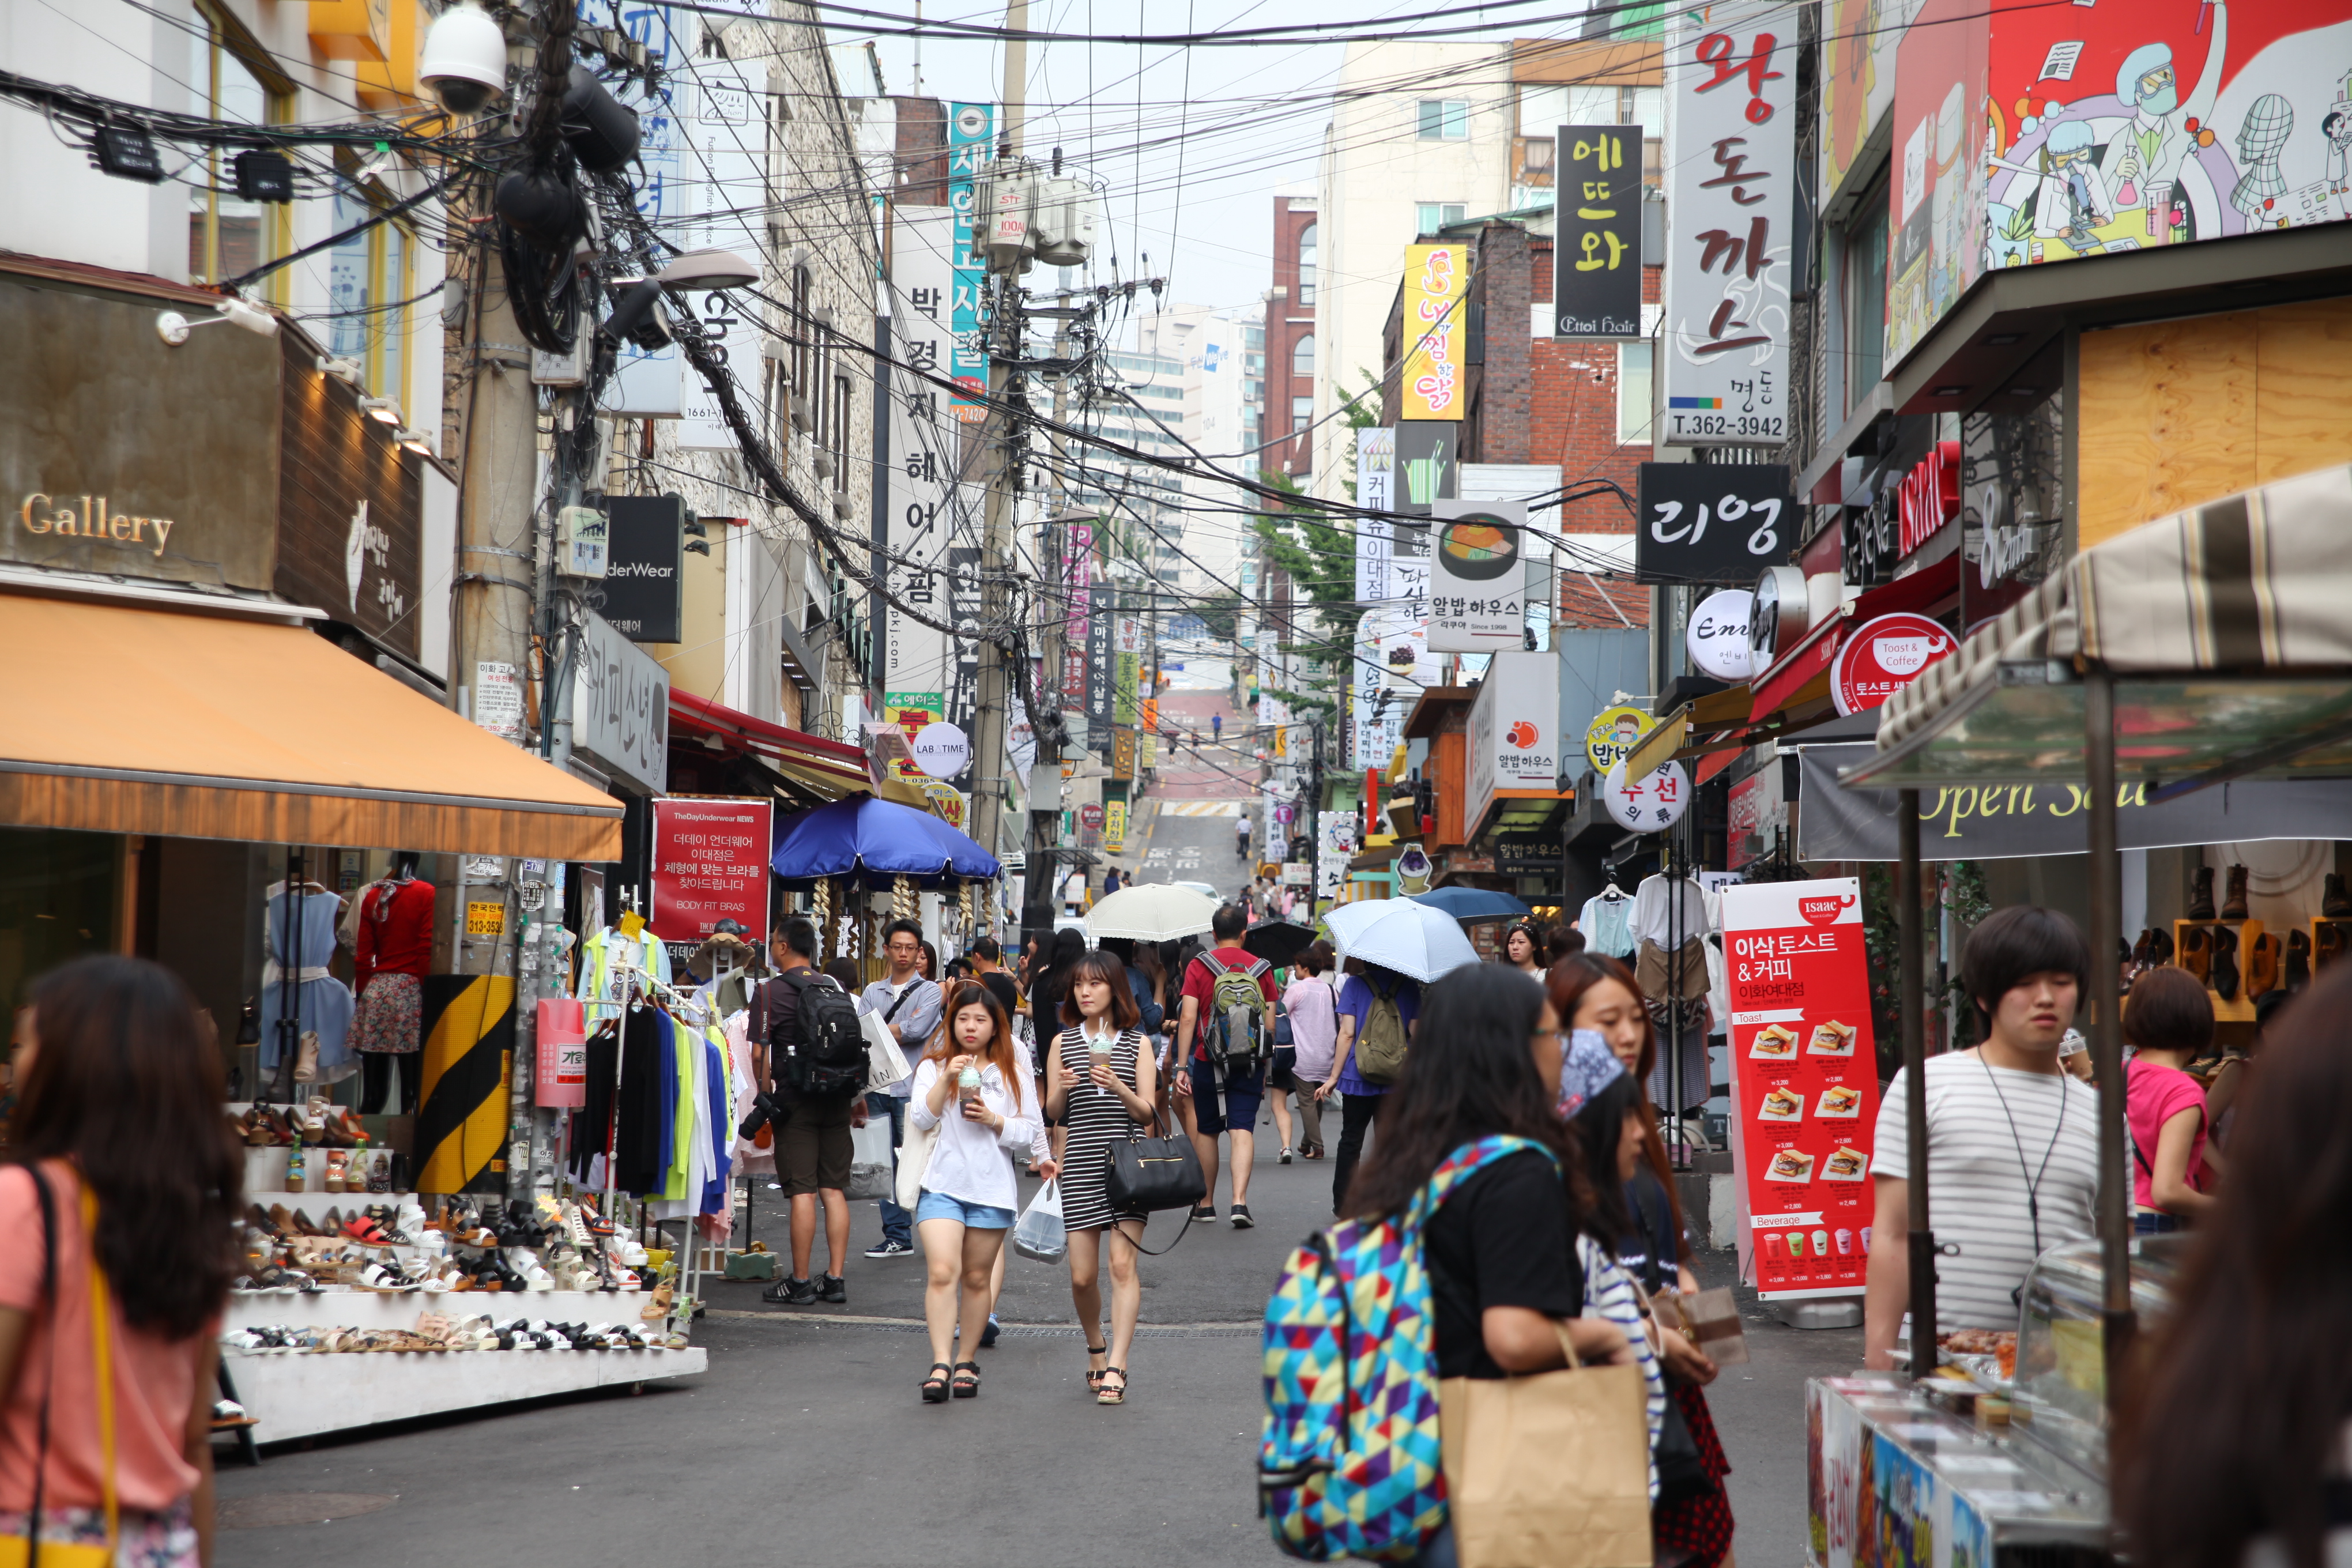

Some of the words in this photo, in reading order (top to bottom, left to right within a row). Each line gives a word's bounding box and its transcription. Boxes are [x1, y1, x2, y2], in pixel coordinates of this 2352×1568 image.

[708, 137, 716, 164] Fusion
[1694, 33, 1785, 355] 왕돈까스
[1573, 133, 1628, 272] 에뜨와
[706, 224, 714, 244] Rice
[1600, 315, 1635, 333] Hair
[1731, 371, 1773, 414] 명동
[1673, 416, 1782, 437] T.362-3942
[23, 494, 172, 557] Gallery
[1651, 494, 1782, 556] 리영
[1441, 621, 1467, 630] 라쿠야
[1883, 643, 1909, 653] Toast
[1911, 643, 1918, 652] &
[1719, 650, 1747, 665] 엔비
[1886, 656, 1918, 666] Coffee
[480, 664, 496, 673] 이화
[488, 675, 514, 684] 여성전용
[904, 694, 938, 706] 에이스
[1842, 681, 1853, 704] Toast
[591, 638, 650, 770] 커피소년
[1590, 723, 1614, 740] 봉구스
[943, 745, 964, 753] TIME
[674, 812, 736, 822] TheDayUnderwear
[1110, 809, 1121, 840] 주차장
[674, 834, 706, 846] 더데이
[710, 835, 753, 848] 언더웨어
[691, 849, 735, 862] 이대점은
[664, 862, 698, 875] 체형에
[701, 864, 723, 876] 맞는
[726, 865, 760, 877] 브라를
[679, 877, 744, 891] 찾아드립니다
[676, 900, 702, 910] BODY
[704, 902, 718, 910] FIT
[720, 902, 745, 912] BRAS
[1735, 936, 1775, 959] 이삭
[1778, 933, 1838, 955] 토스트
[1737, 963, 1752, 982] &
[1754, 958, 1792, 981] 커피
[1739, 982, 1804, 999] 이화여대점
[1738, 1013, 1762, 1023] Toast
[1757, 1216, 1800, 1226] Beverage
